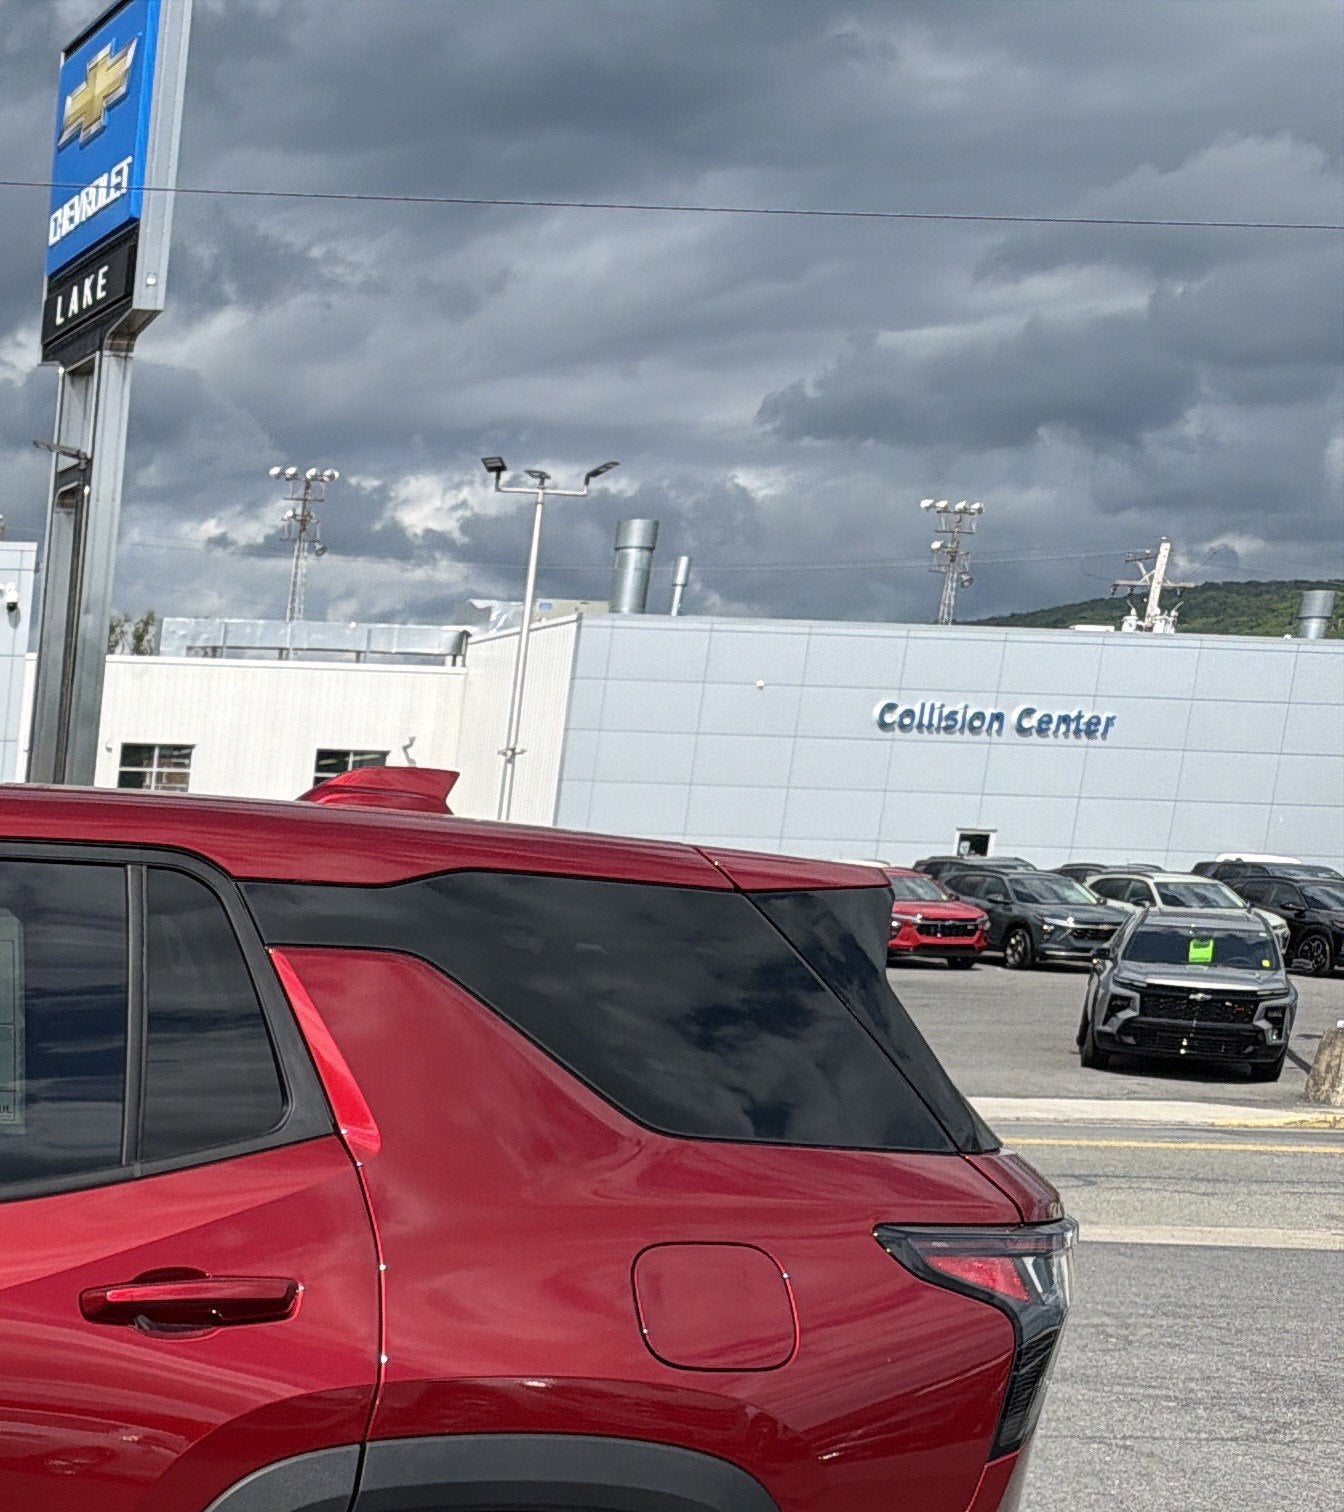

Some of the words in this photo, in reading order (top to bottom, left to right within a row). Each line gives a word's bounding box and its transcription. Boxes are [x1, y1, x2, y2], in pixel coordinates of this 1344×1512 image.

[47, 155, 133, 247] CHEVROLET
[55, 265, 109, 326] LAKE
[875, 701, 1006, 735] Collision
[1014, 706, 1116, 739] Center
